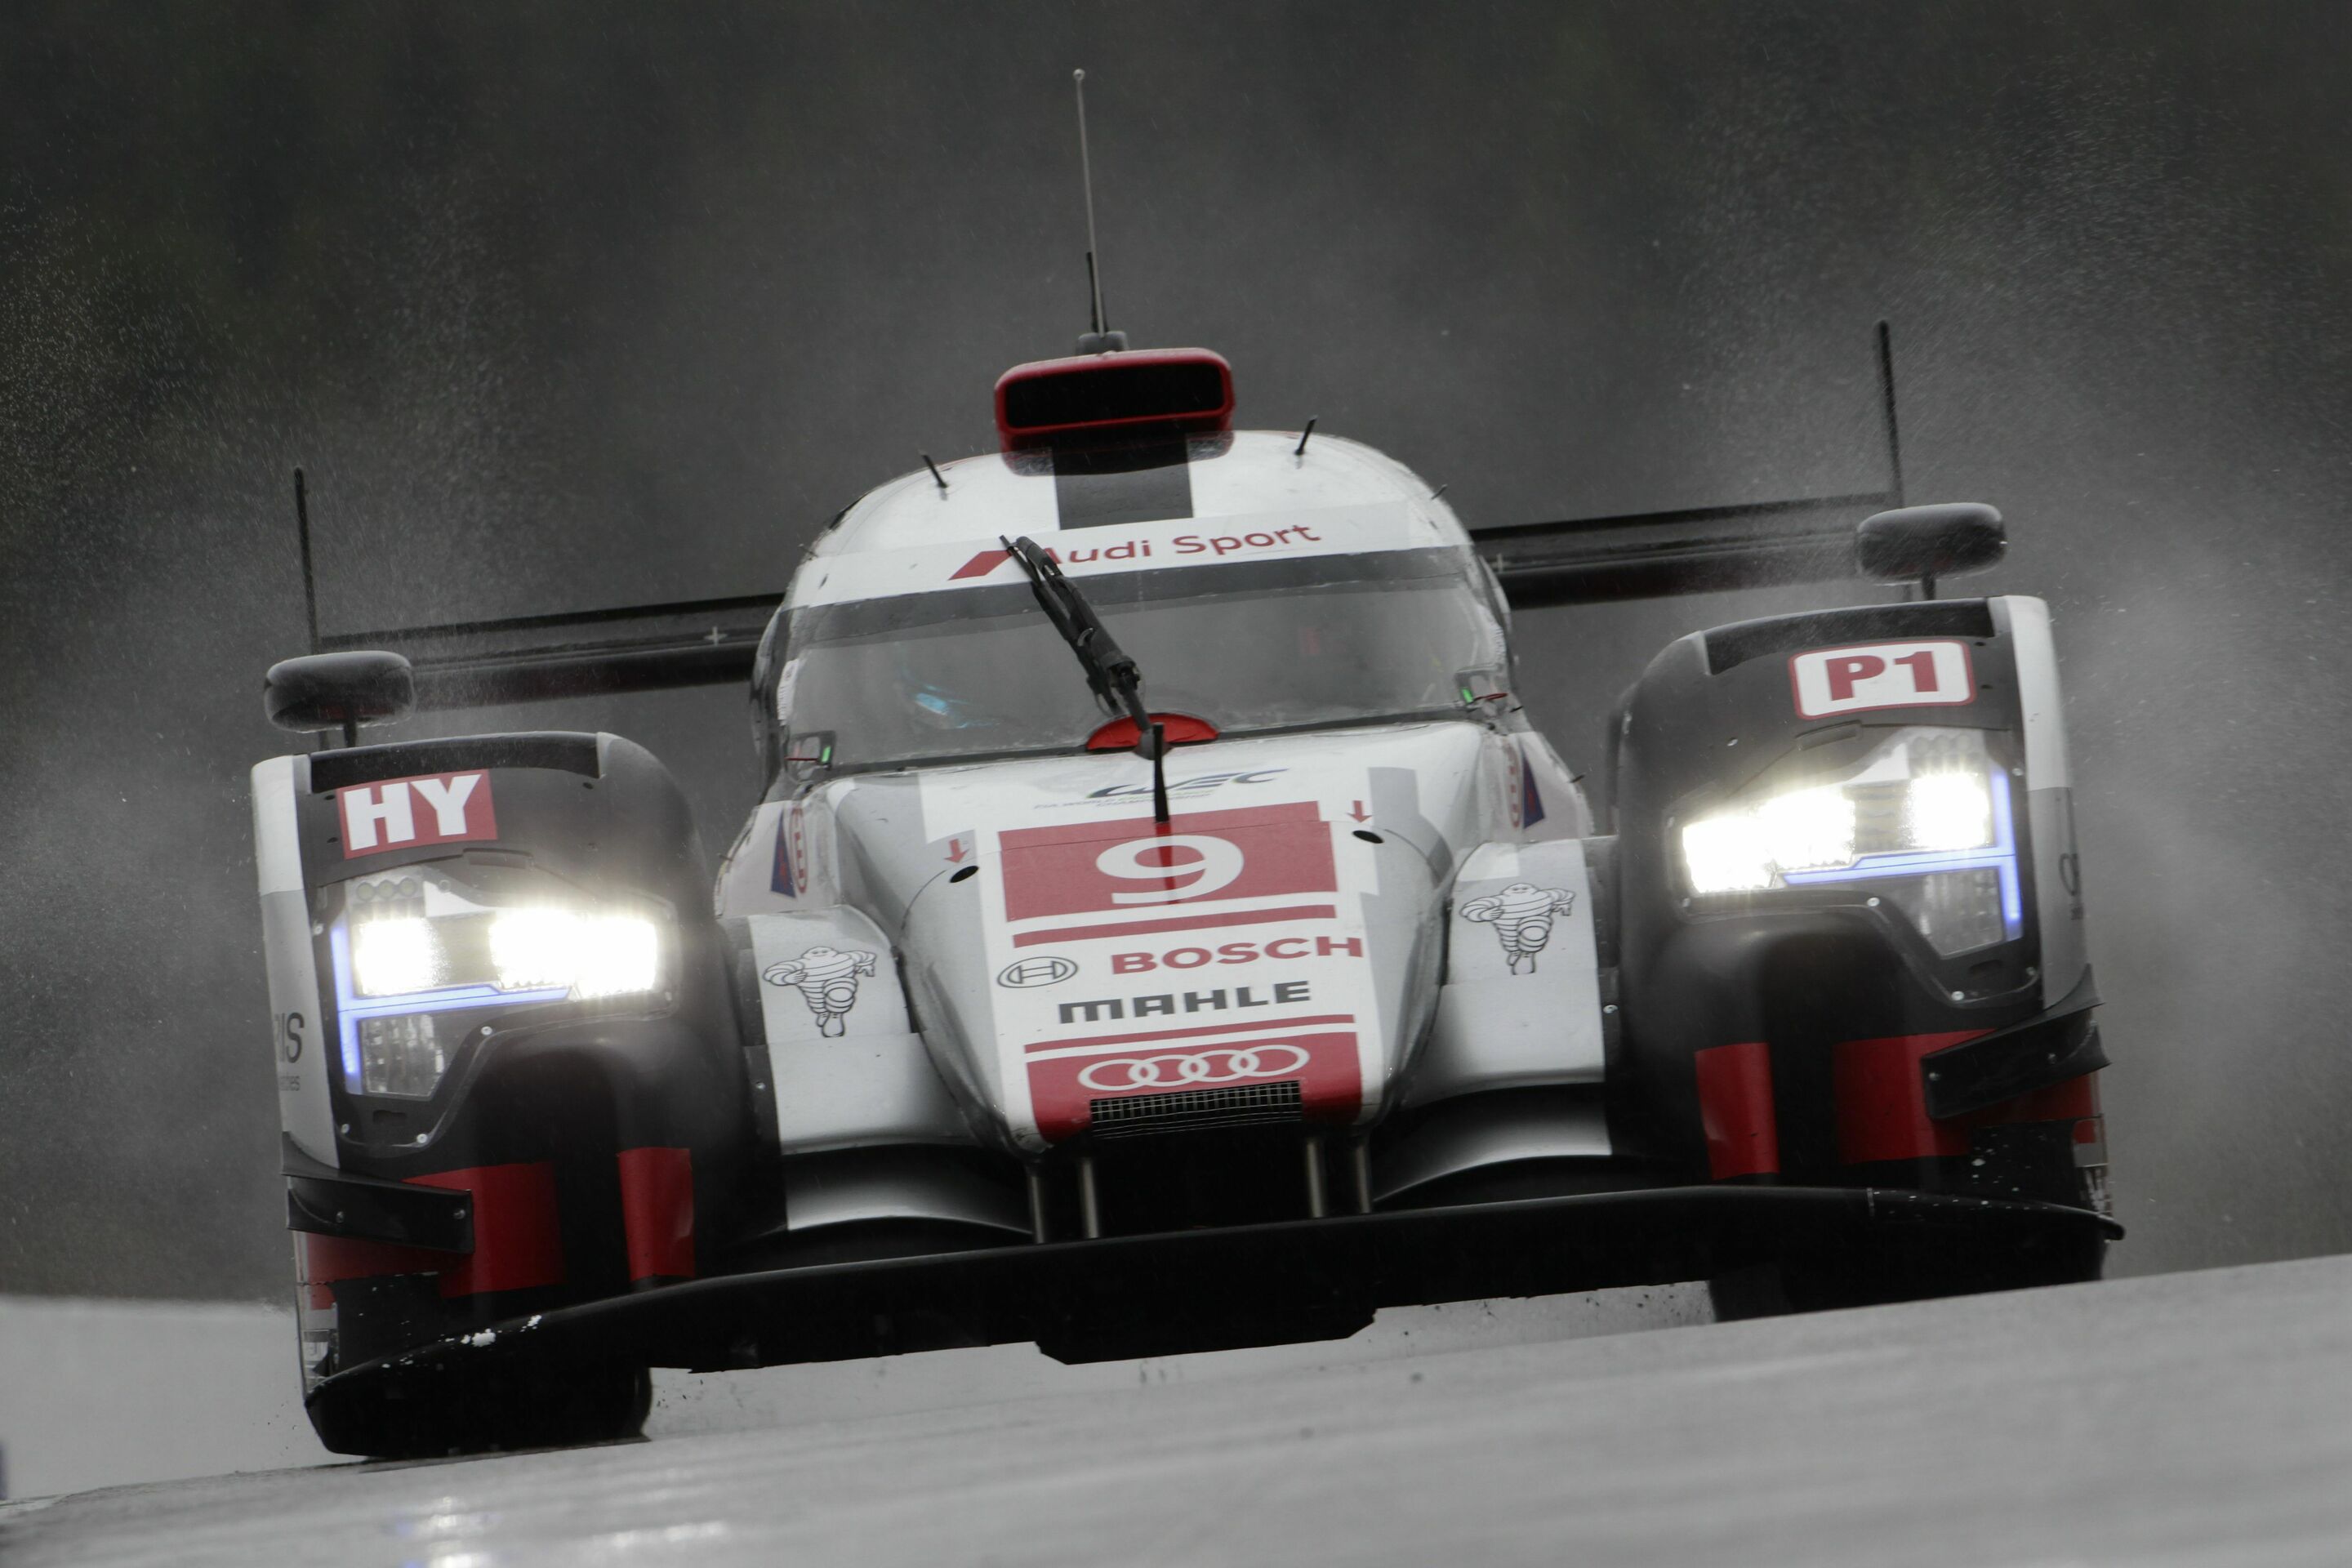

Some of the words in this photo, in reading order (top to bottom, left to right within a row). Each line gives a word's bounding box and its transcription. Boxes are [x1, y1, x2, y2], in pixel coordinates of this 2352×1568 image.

[1173, 524, 1321, 556] Sport
[1824, 650, 1940, 702] P1
[344, 774, 481, 850] HY
[1095, 835, 1245, 905] 9
[1111, 937, 1363, 974] BOSCH
[1058, 982, 1311, 1024] MAHLE
